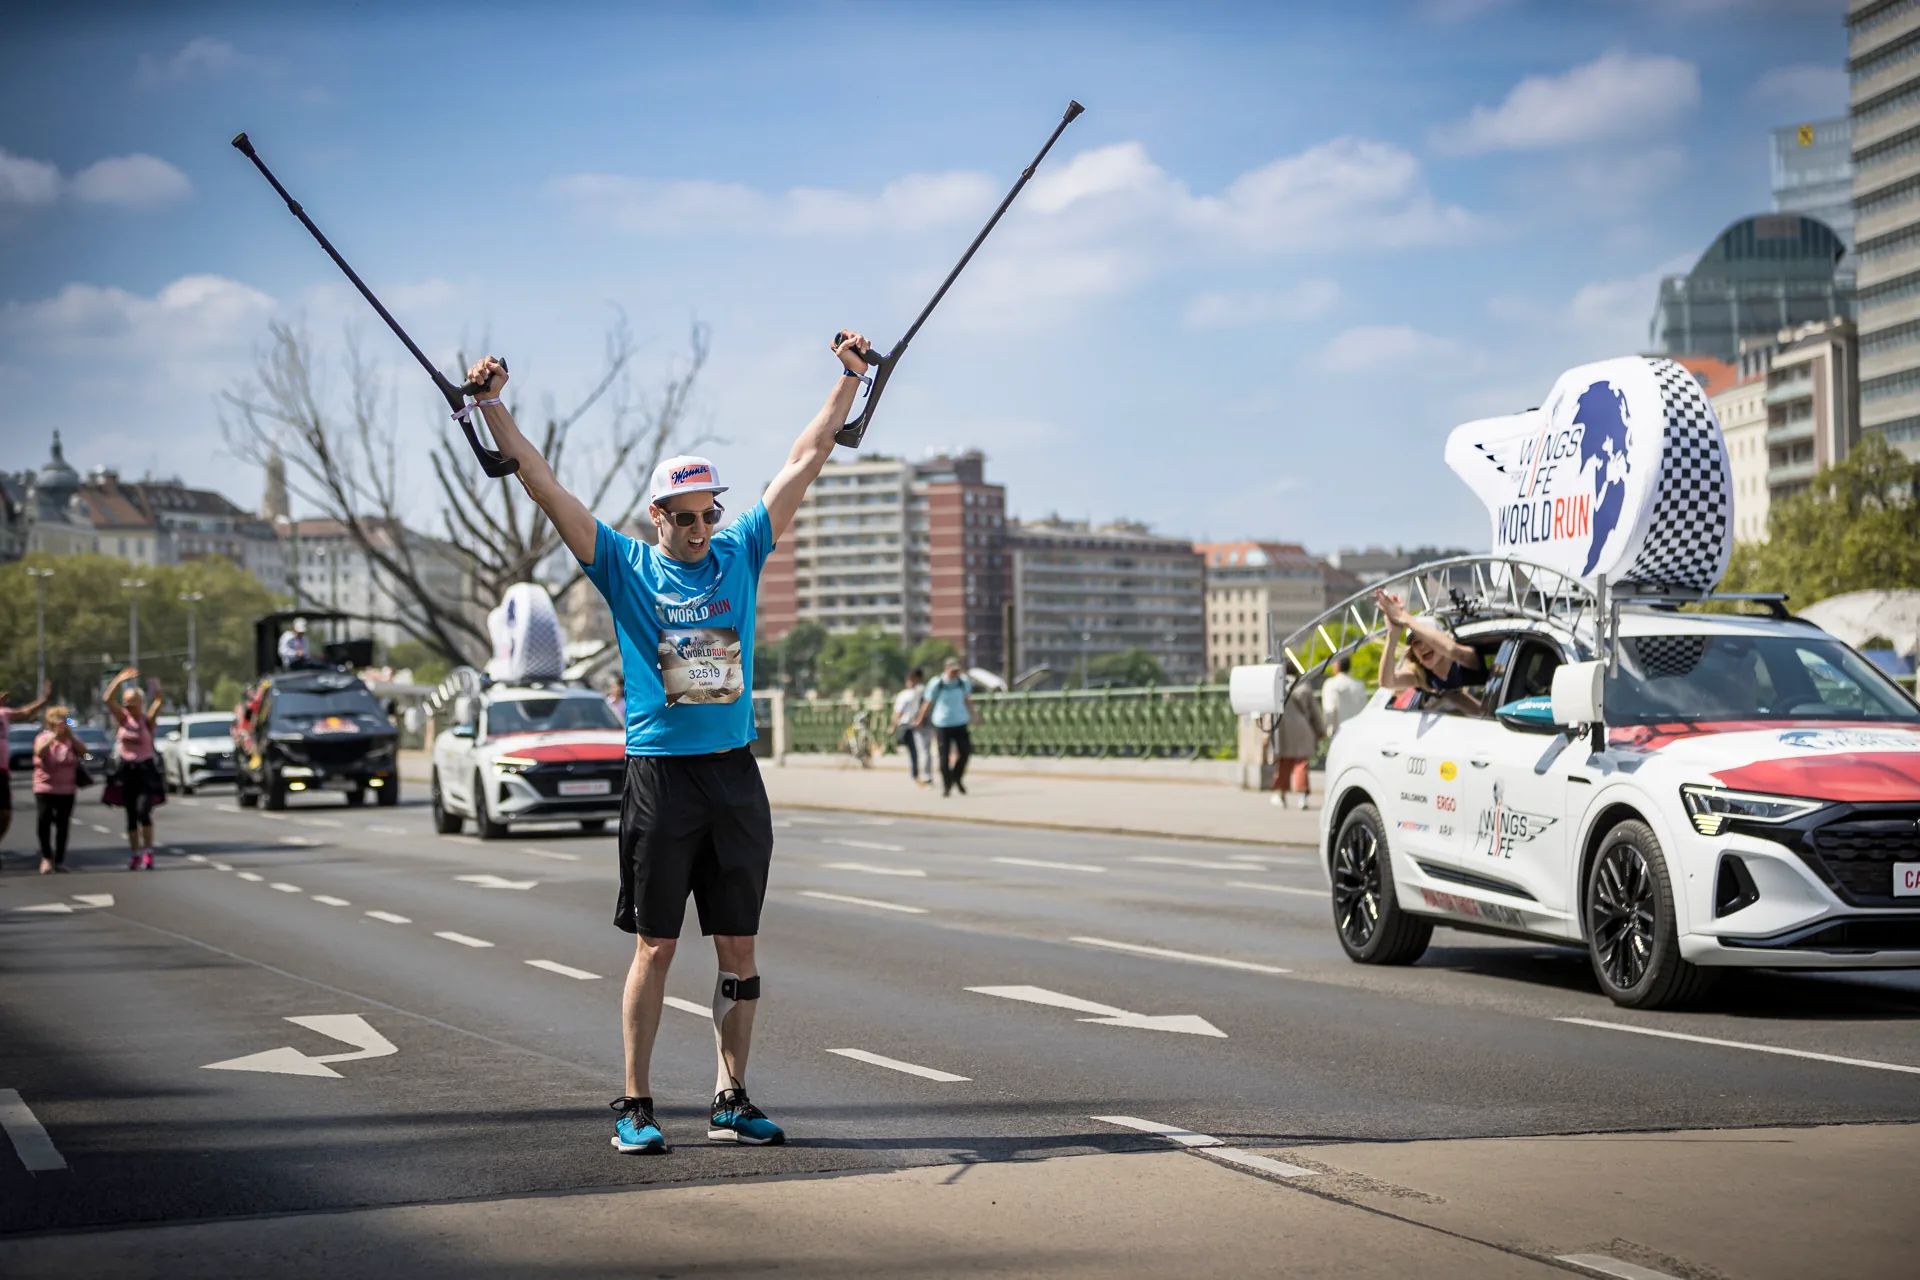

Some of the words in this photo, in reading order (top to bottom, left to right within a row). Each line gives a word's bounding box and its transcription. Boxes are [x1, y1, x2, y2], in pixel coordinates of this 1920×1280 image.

[1519, 428, 1582, 465] WINGS
[671, 465, 709, 485] Manner
[1518, 465, 1558, 498] LIFE
[688, 668, 720, 680] 32519
[1437, 795, 1457, 812] ERGO
[1481, 807, 1528, 837] WINGS
[1487, 835, 1515, 859] LIFE
